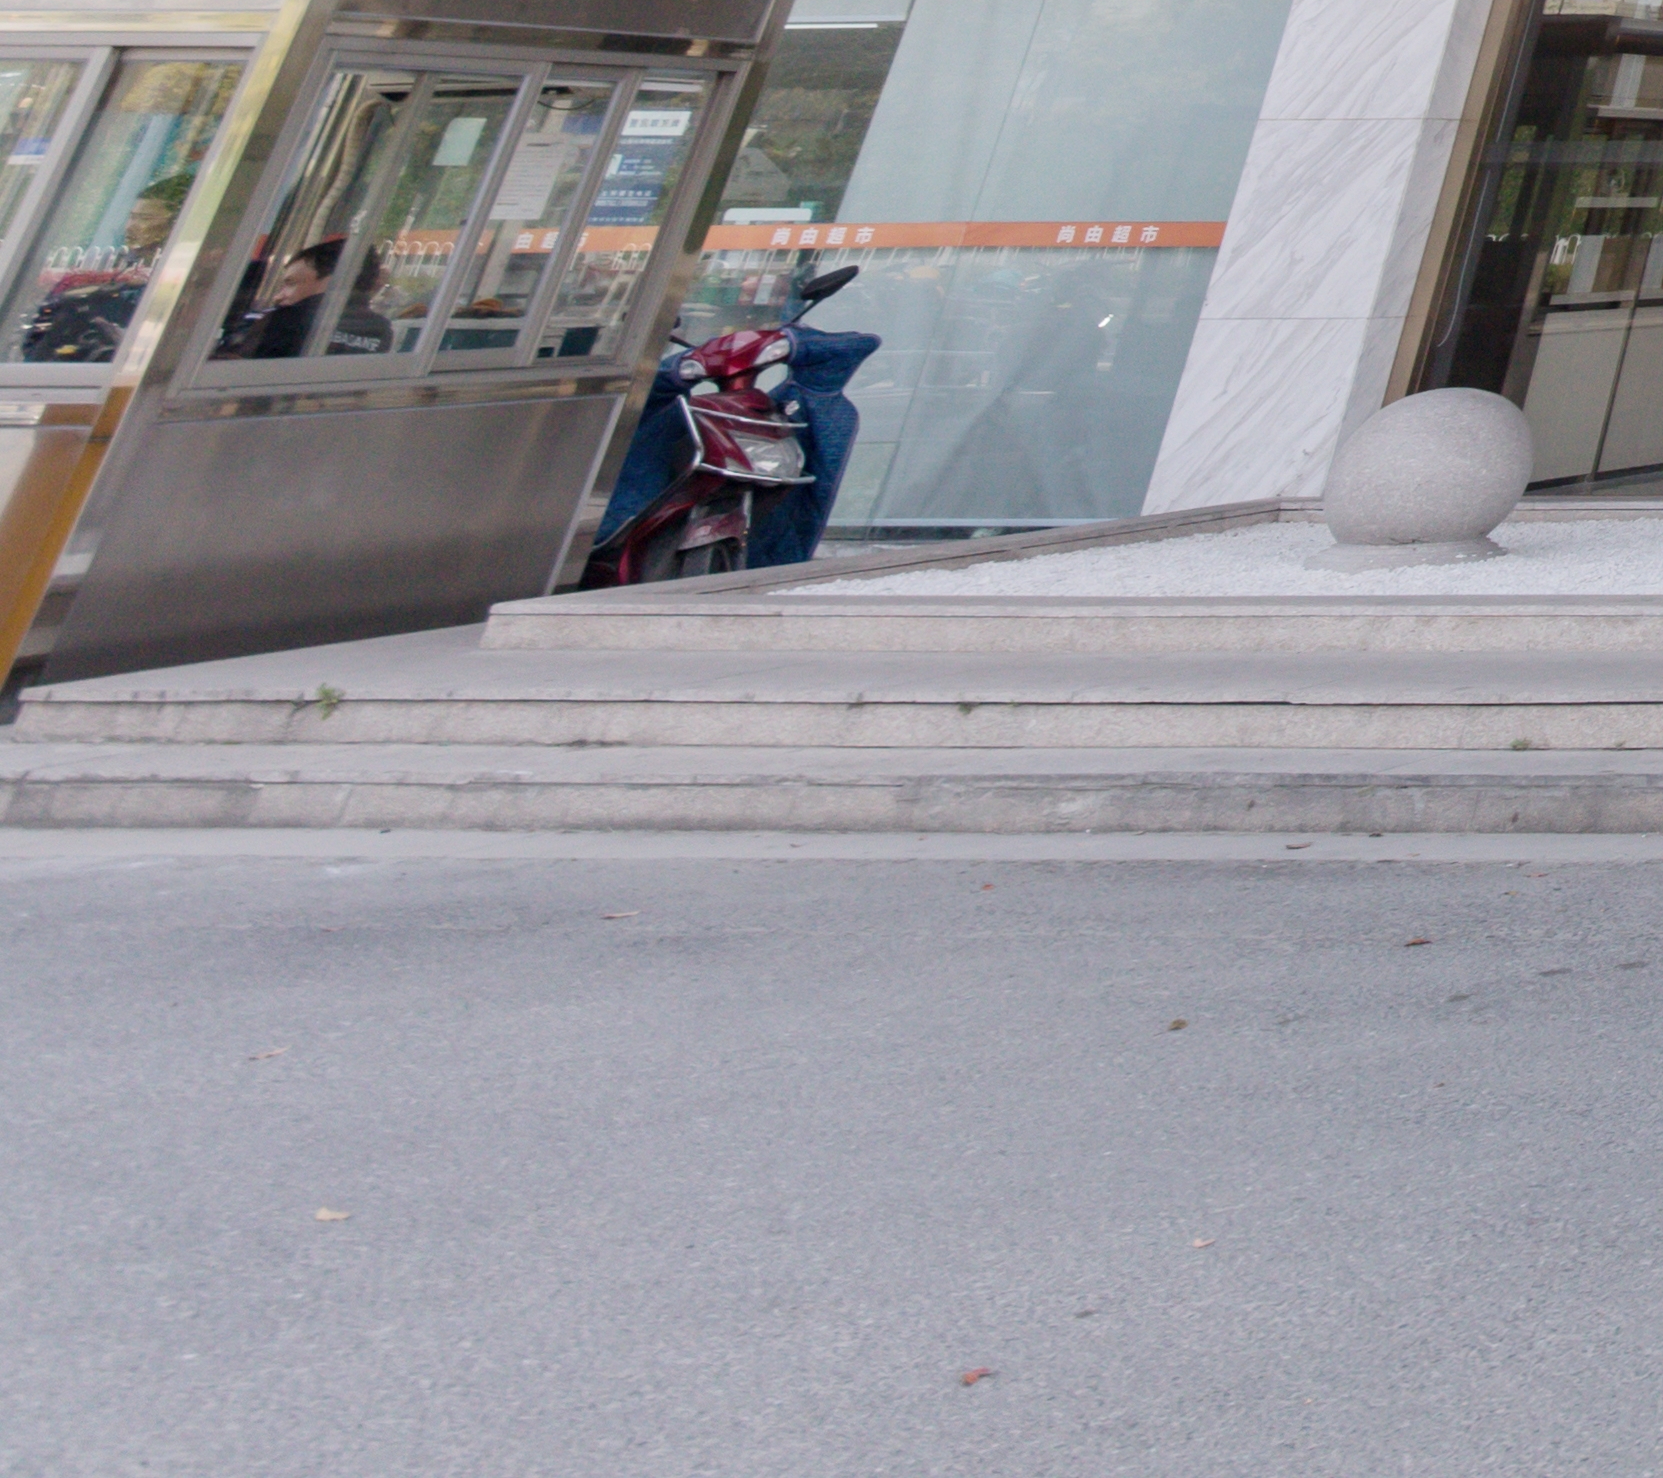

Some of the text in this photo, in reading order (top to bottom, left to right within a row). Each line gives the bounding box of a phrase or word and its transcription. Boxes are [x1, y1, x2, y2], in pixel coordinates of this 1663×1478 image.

[769, 226, 877, 246] 尚由超市
[1055, 224, 1161, 244] 尚由超市
